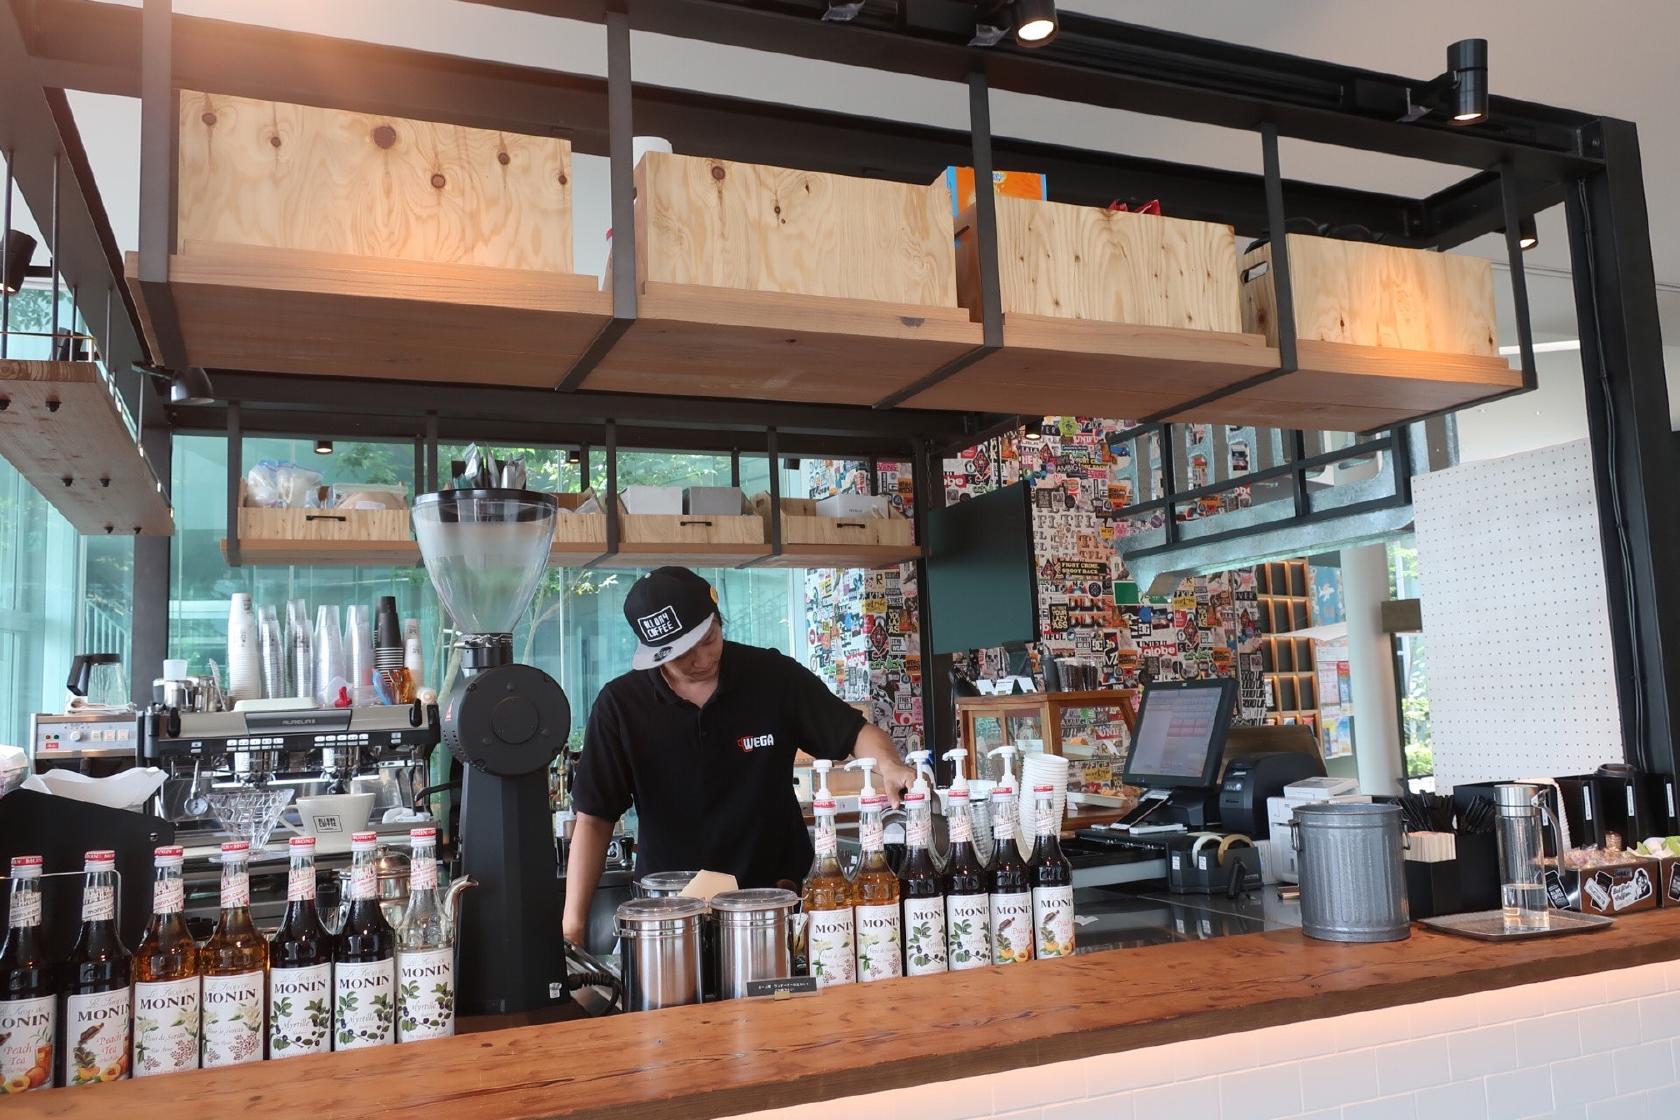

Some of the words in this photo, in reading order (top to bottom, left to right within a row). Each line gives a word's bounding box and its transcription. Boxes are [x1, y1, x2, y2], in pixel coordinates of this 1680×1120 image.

[647, 621, 674, 638] COFFEE
[743, 734, 775, 750] WEGA
[1041, 899, 1072, 910] MONI
[402, 962, 450, 978] MONIN
[275, 980, 326, 995] MONIN
[340, 975, 390, 990] MONIN
[140, 993, 196, 1010] MONIN
[1, 1012, 50, 1029] ONIN
[79, 1004, 131, 1022] MONIN
